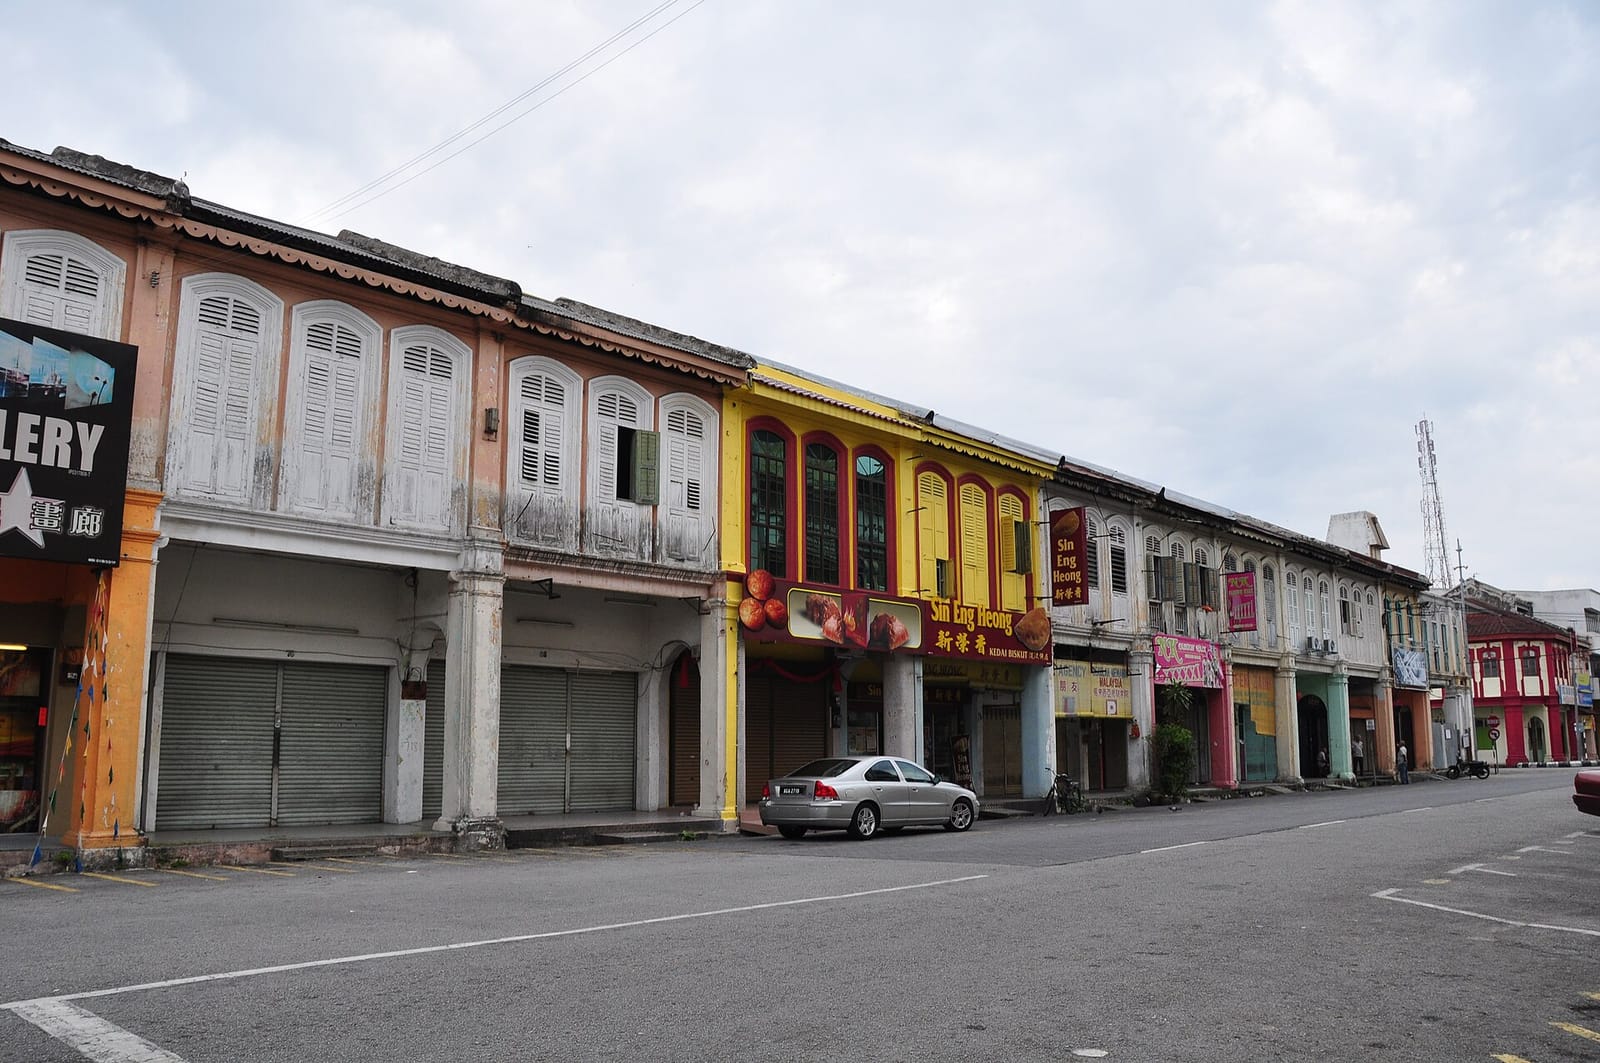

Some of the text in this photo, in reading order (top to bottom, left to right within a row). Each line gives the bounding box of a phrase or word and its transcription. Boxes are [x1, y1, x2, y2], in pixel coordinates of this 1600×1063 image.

[30, 502, 102, 536] 畫廊
[1057, 539, 1074, 551] Sin
[1057, 554, 1077, 569] Eng
[1053, 570, 1081, 584] Heong
[931, 596, 1012, 637] Sin Eng Heong
[989, 647, 1007, 657] KEDAI
[1008, 649, 1028, 660] BISKUT
[866, 684, 882, 697] Sin
